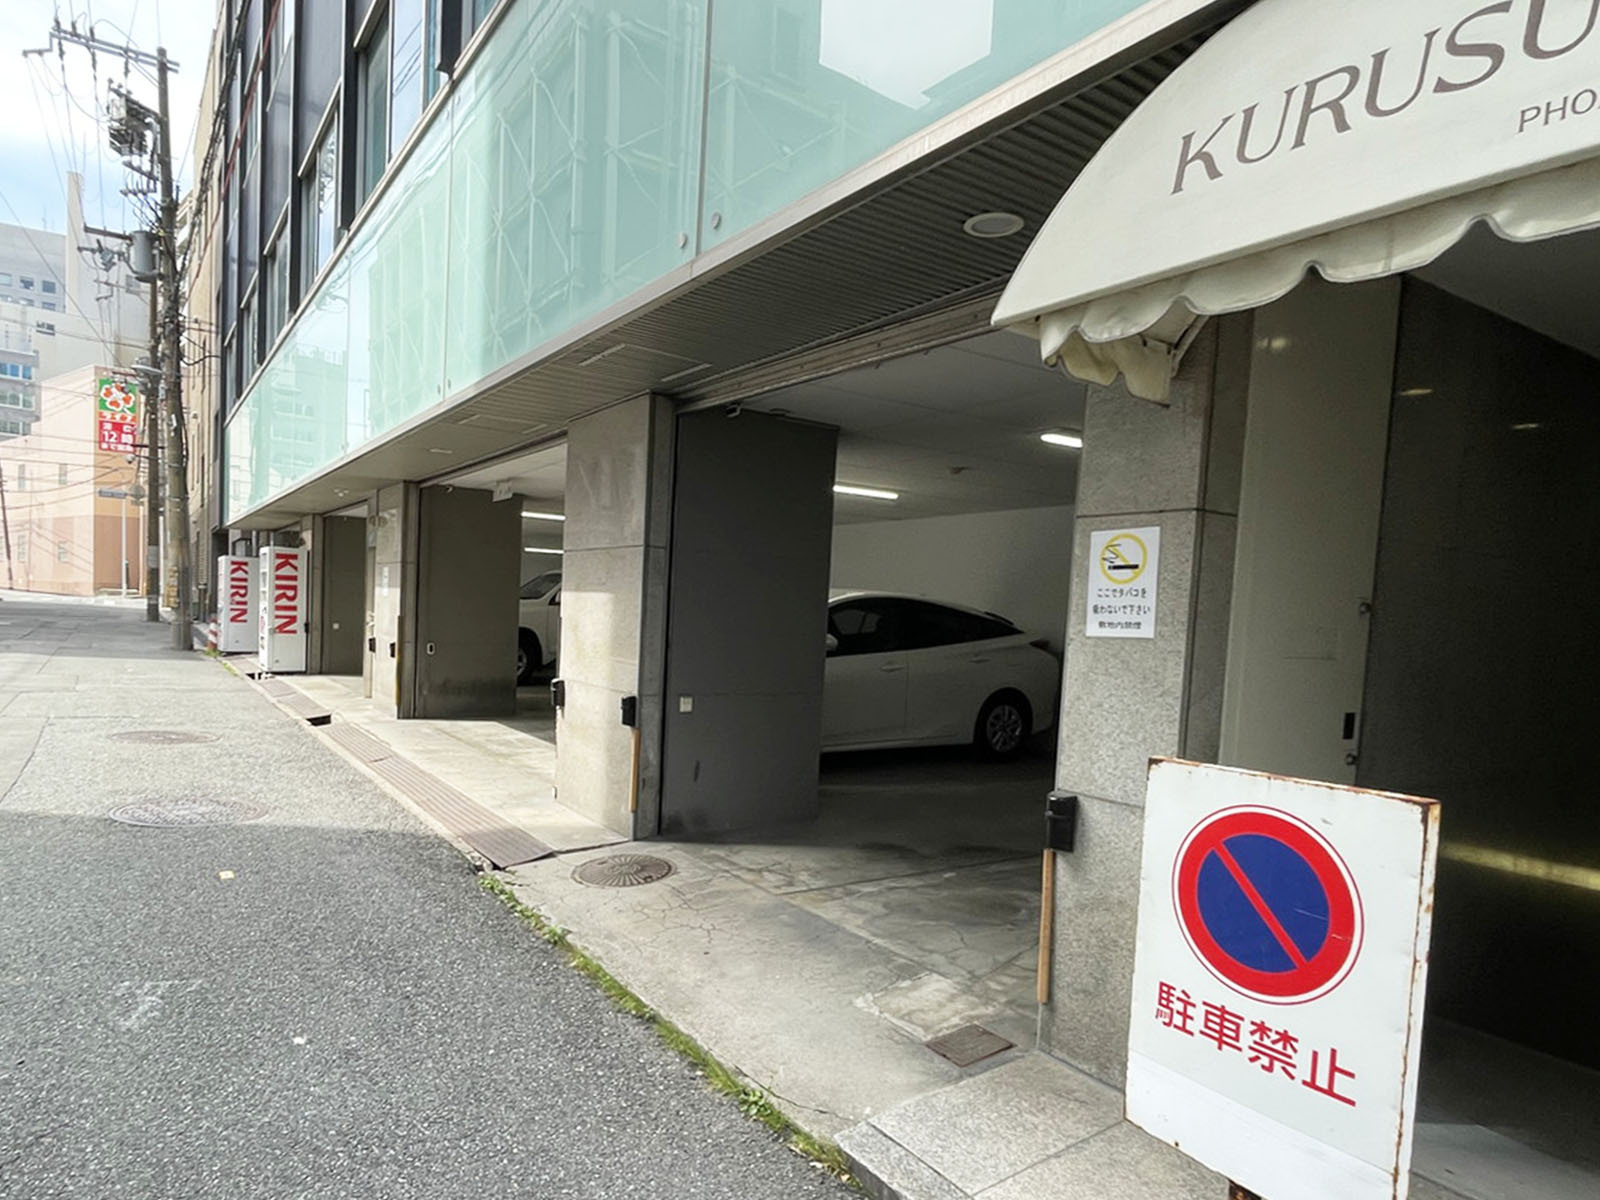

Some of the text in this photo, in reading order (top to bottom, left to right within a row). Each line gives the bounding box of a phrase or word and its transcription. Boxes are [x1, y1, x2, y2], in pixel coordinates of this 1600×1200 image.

[1171, 0, 1600, 195] KURUSU
[1518, 88, 1600, 134] PHO
[230, 560, 249, 623] KIRIN
[273, 553, 299, 635] KIRIN
[1155, 980, 1357, 1108] 駐車禁止
